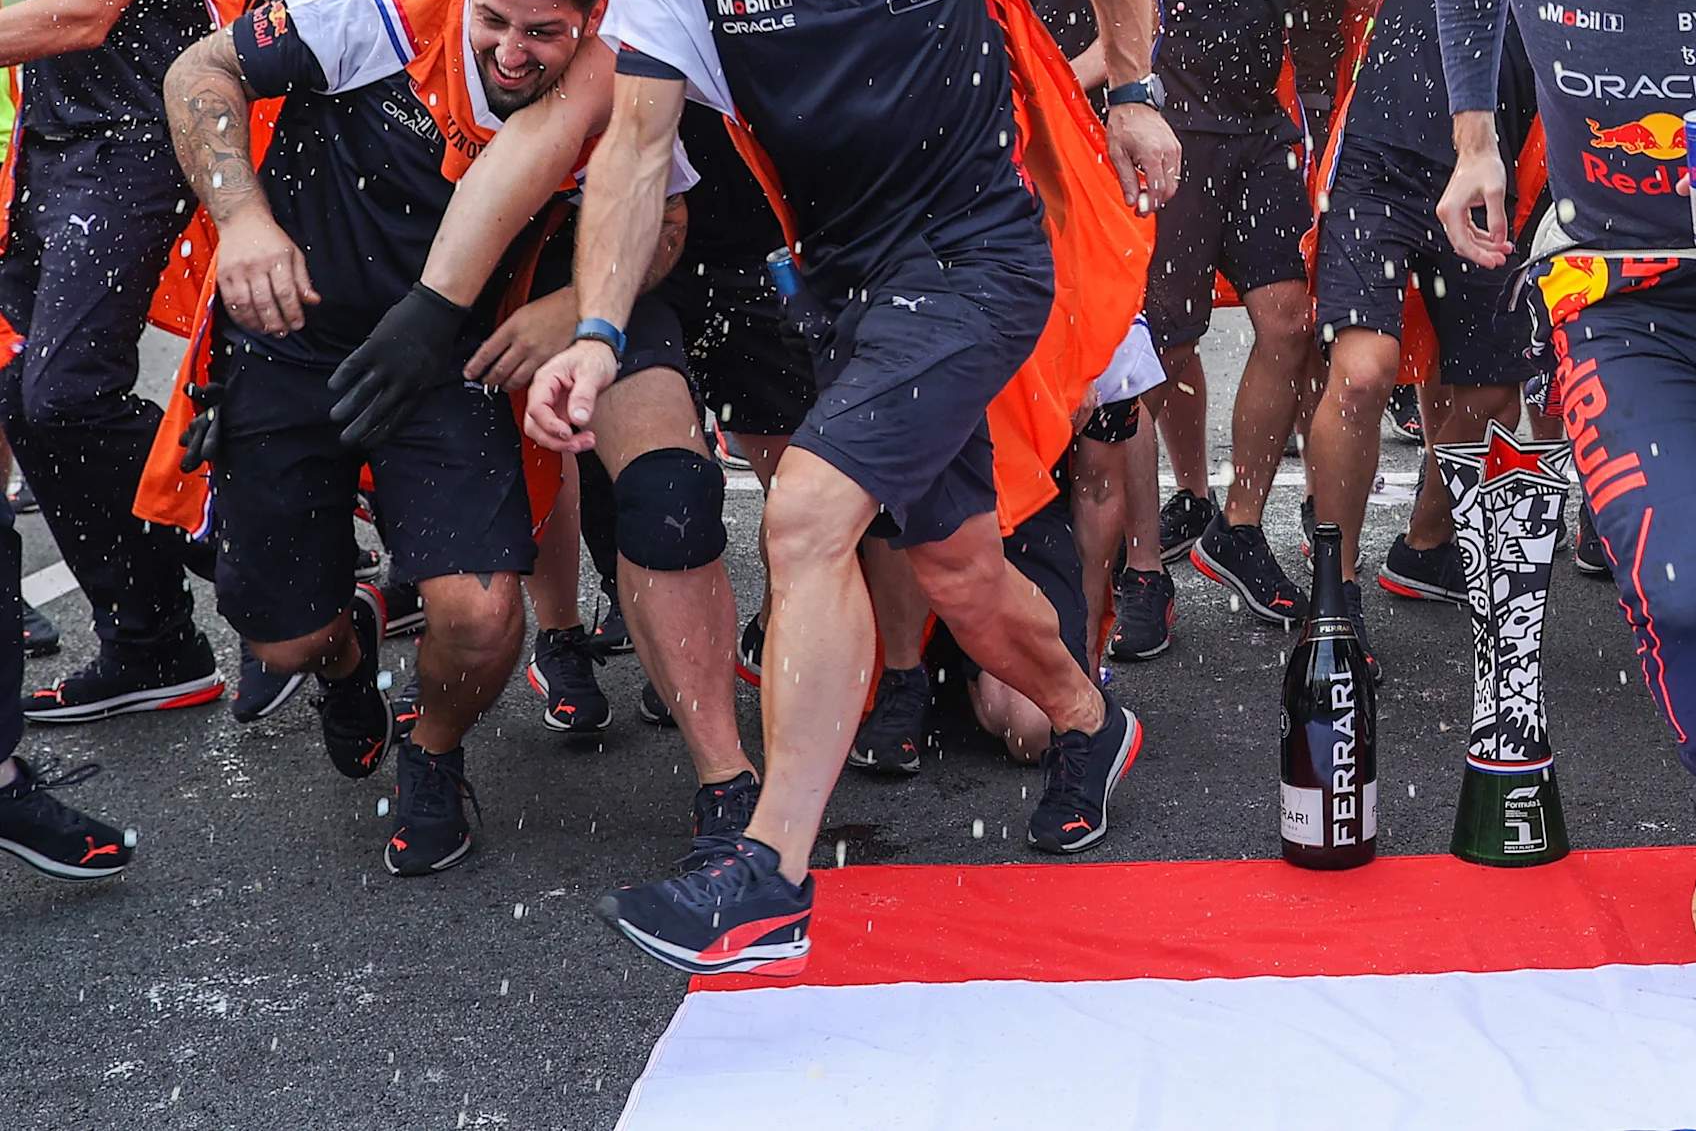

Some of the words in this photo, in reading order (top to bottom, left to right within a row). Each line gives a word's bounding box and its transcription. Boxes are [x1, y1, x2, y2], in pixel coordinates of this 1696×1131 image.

[253, 19, 274, 48] Bull
[722, 12, 797, 35] ORACLE
[1547, 2, 1601, 30] Mobil
[382, 101, 427, 140] ORACL
[1581, 151, 1673, 195] Red
[1563, 374, 1649, 516] Bull
[1329, 670, 1357, 849] FERRARI
